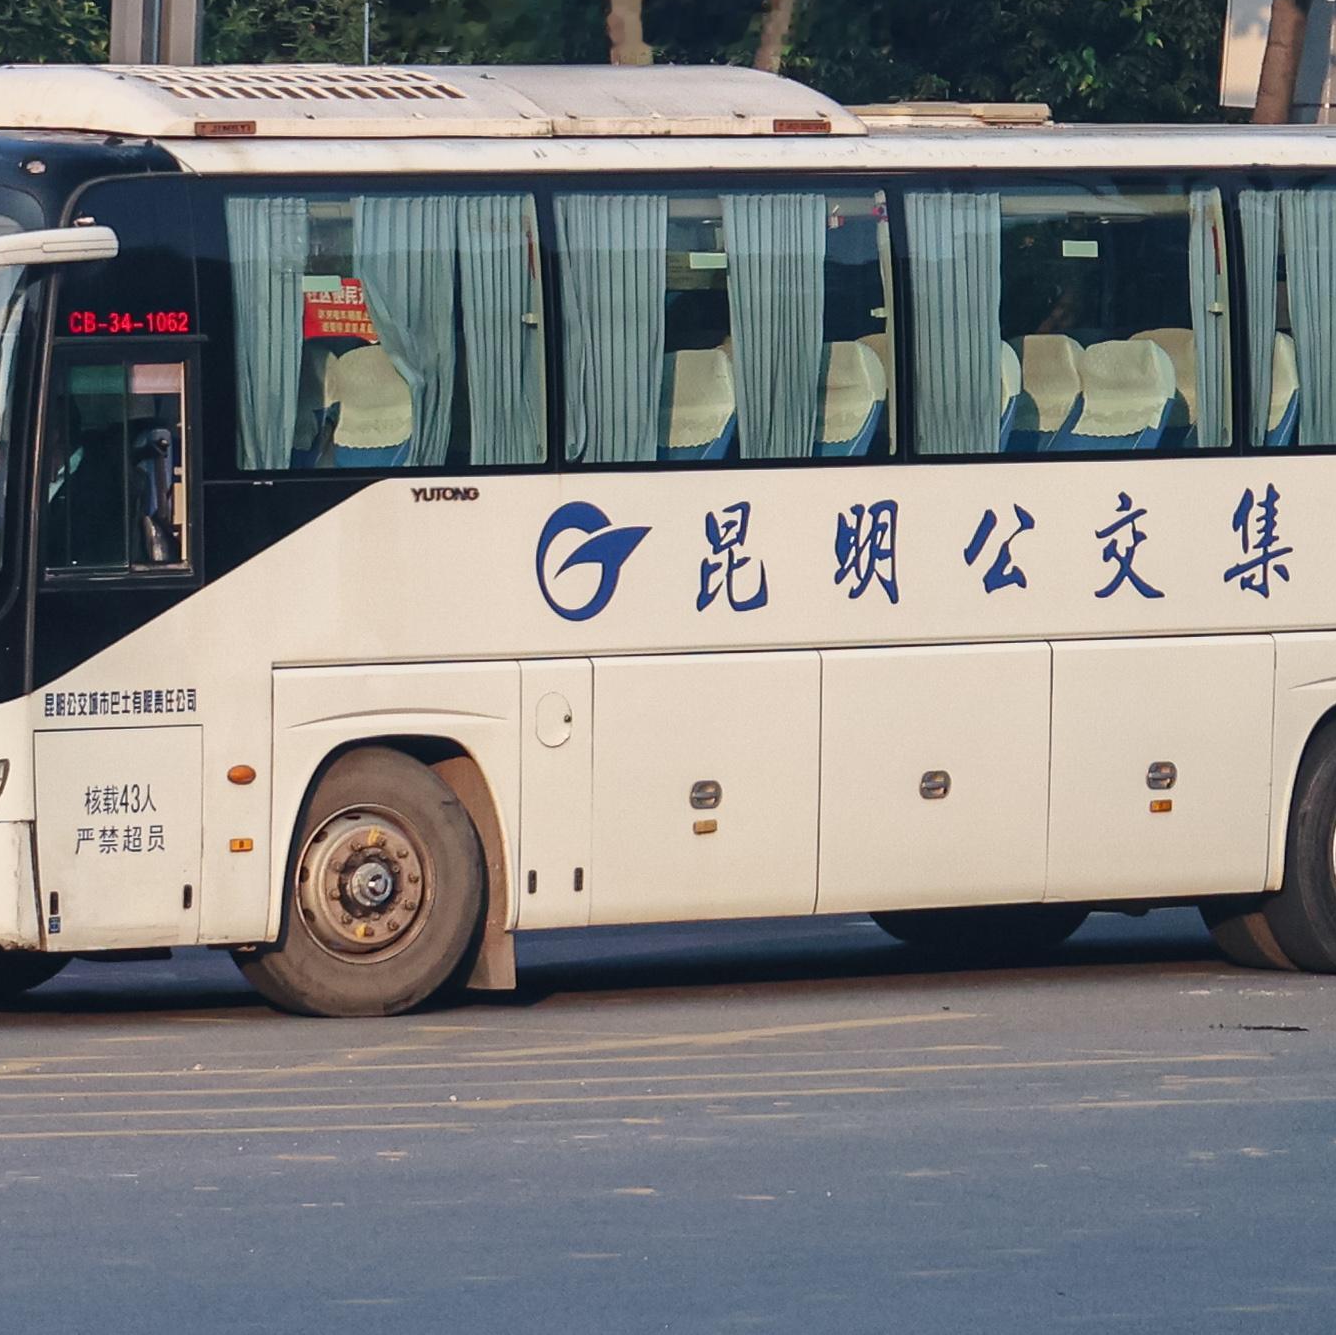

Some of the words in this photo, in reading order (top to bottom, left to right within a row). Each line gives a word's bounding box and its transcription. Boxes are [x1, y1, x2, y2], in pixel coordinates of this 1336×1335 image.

[69, 311, 189, 333] CB-34-1062
[410, 487, 480, 502] YUTONG
[44, 688, 197, 717] 昆明公交城市巴士有限责任公司
[84, 783, 157, 815] 核载43人
[75, 825, 165, 854] 严禁超员
